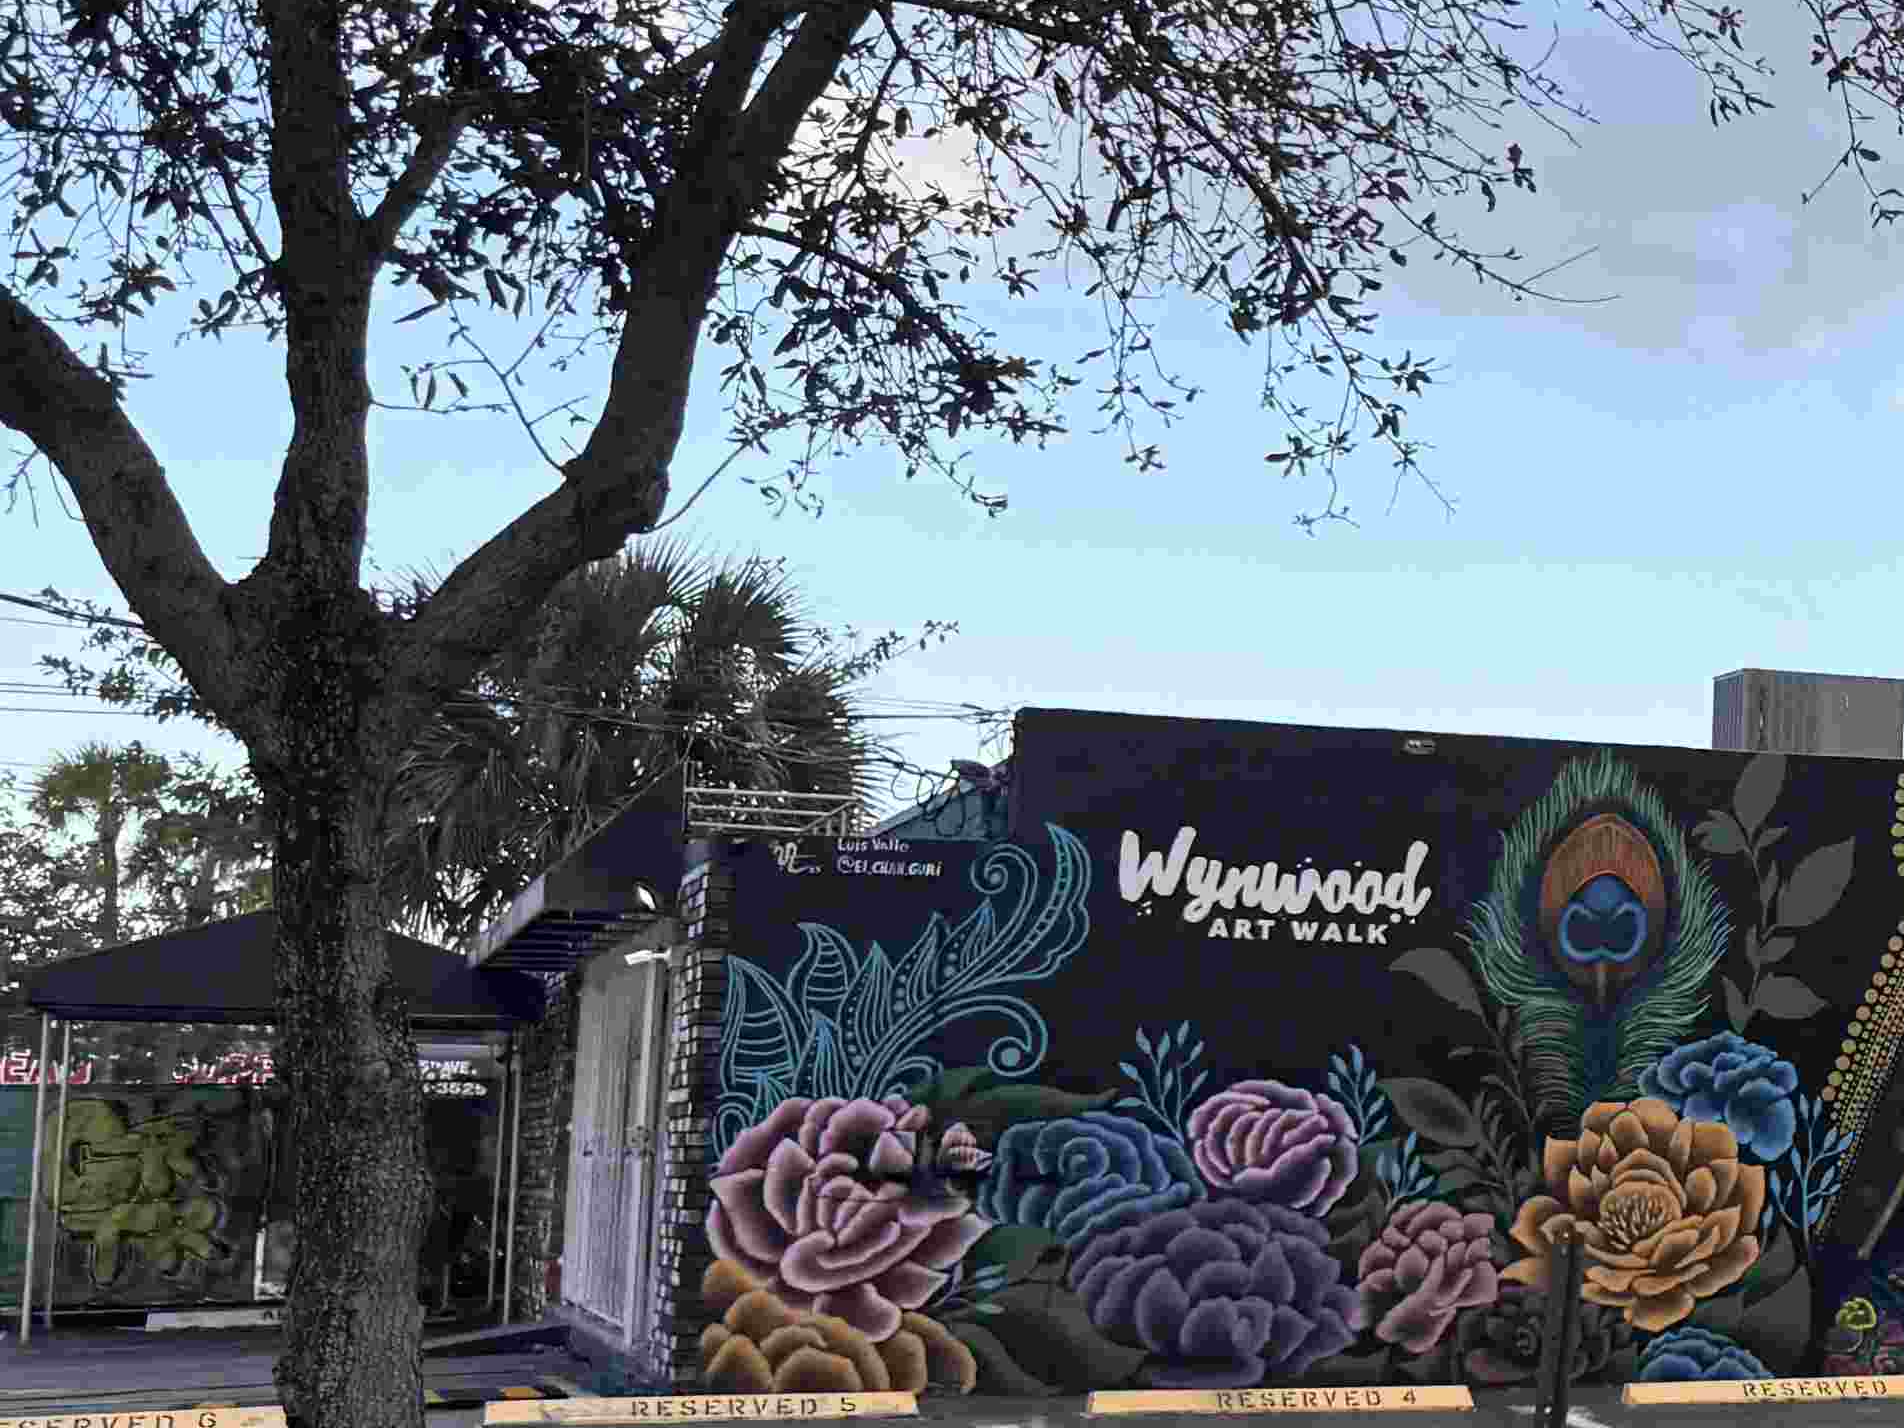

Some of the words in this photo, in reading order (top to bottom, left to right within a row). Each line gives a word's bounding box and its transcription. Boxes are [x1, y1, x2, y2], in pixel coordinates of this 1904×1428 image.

[1119, 825, 1432, 923] Wynwood
[1207, 917, 1276, 942] ART
[1290, 920, 1390, 946] WALK
[1742, 1378, 1888, 1398] RESERVED
[631, 1397, 817, 1417] RESERVED
[840, 1396, 856, 1412] 5
[1216, 1389, 1382, 1409] RESERVED
[1402, 1389, 1417, 1405] 4
